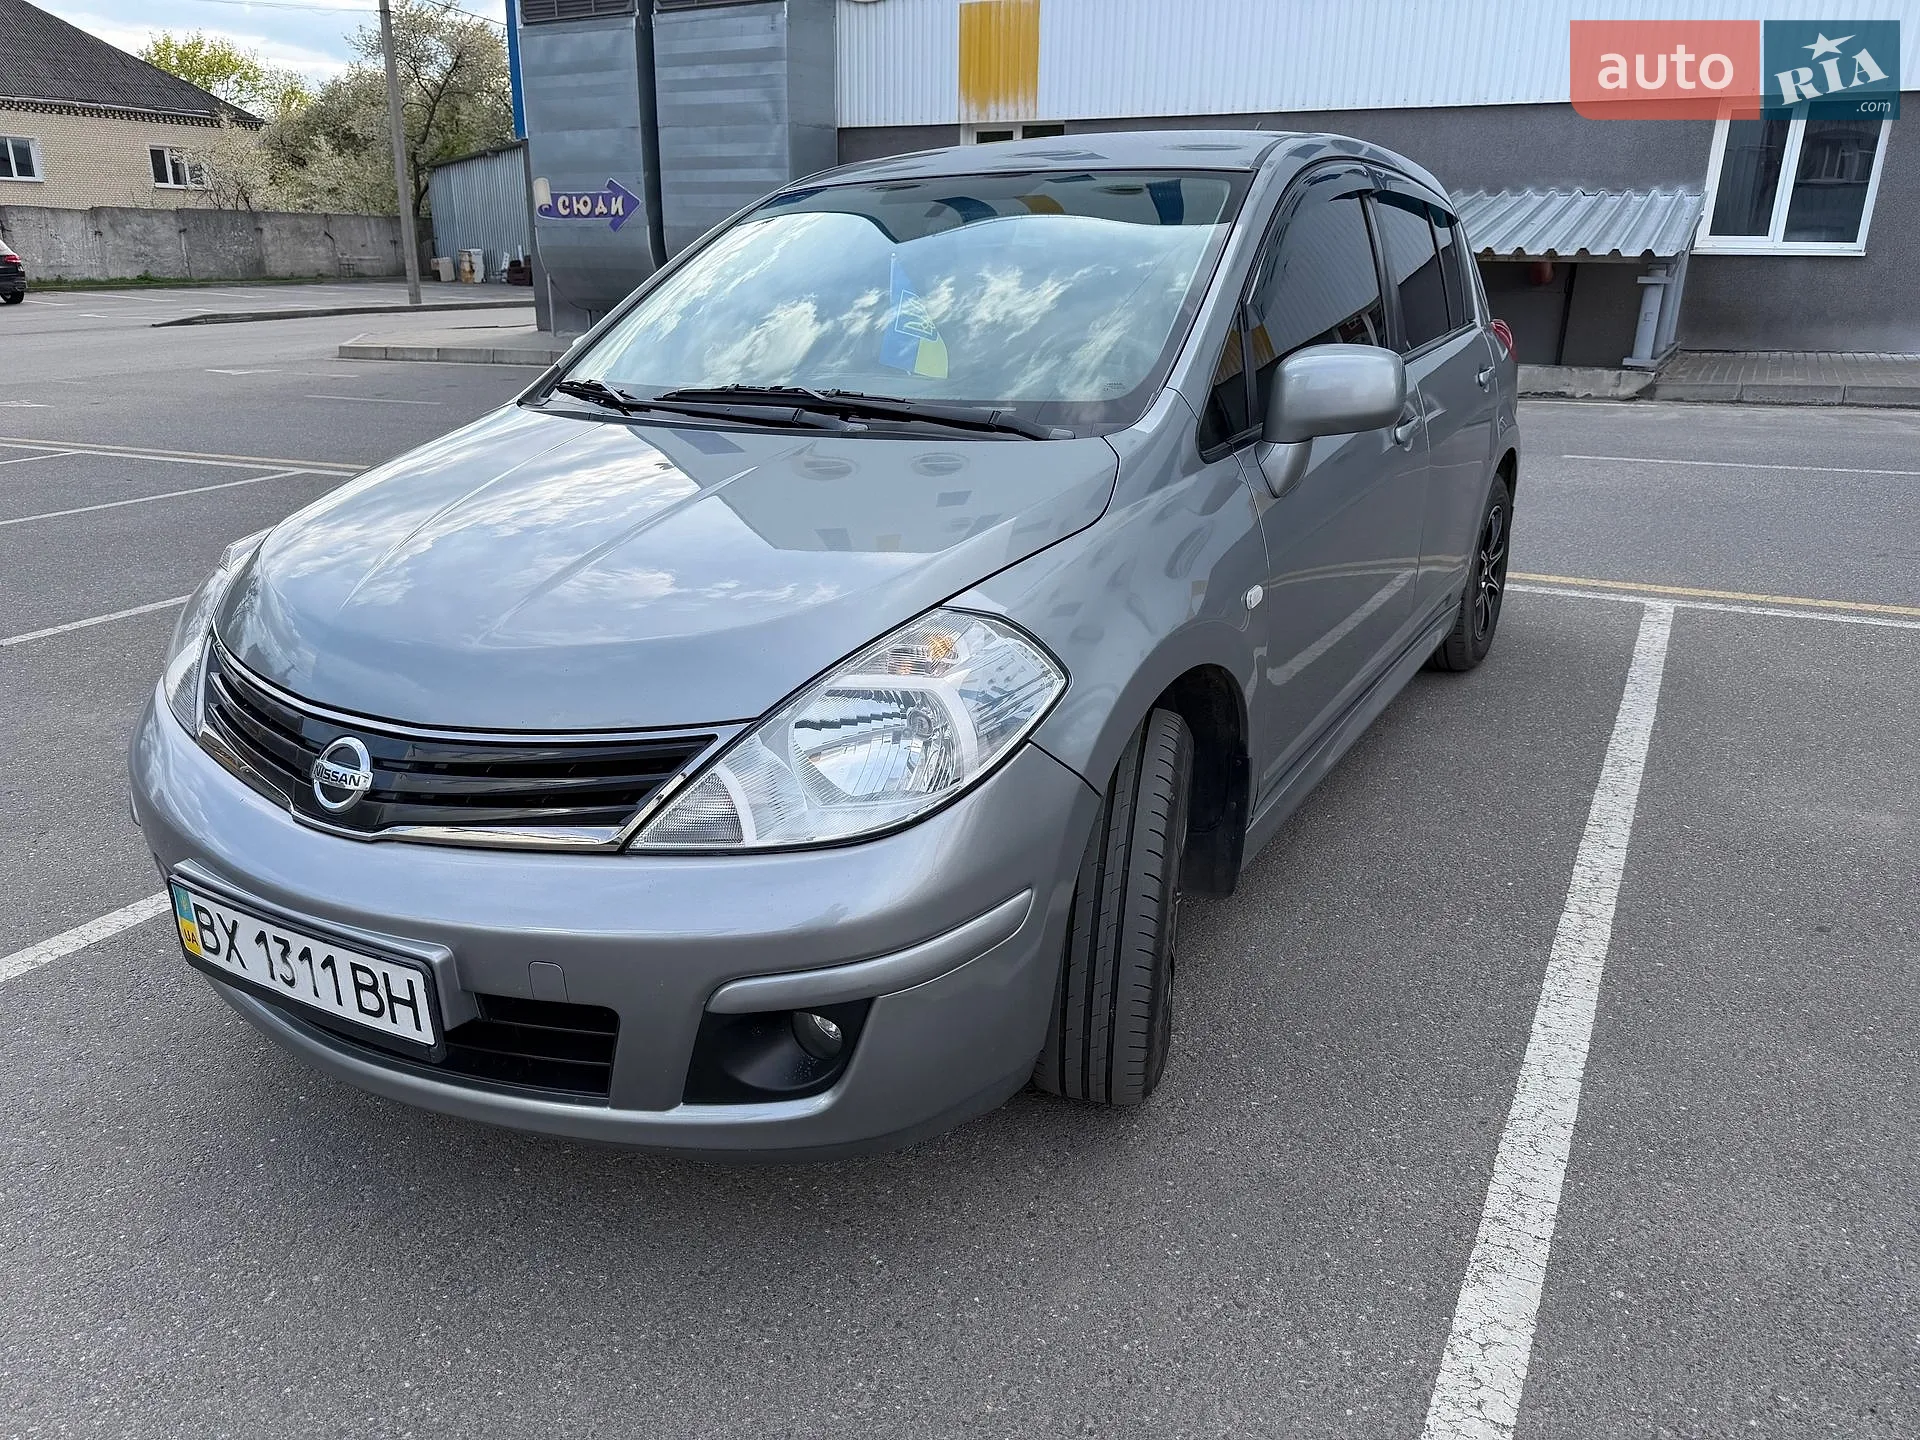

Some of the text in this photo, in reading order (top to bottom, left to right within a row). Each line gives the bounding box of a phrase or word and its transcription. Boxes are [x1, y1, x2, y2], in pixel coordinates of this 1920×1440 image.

[557, 195, 625, 216] СЮДИ
[313, 761, 362, 788] NISSAN
[183, 929, 199, 946] UA
[193, 902, 423, 1032] BX 1311 BH
